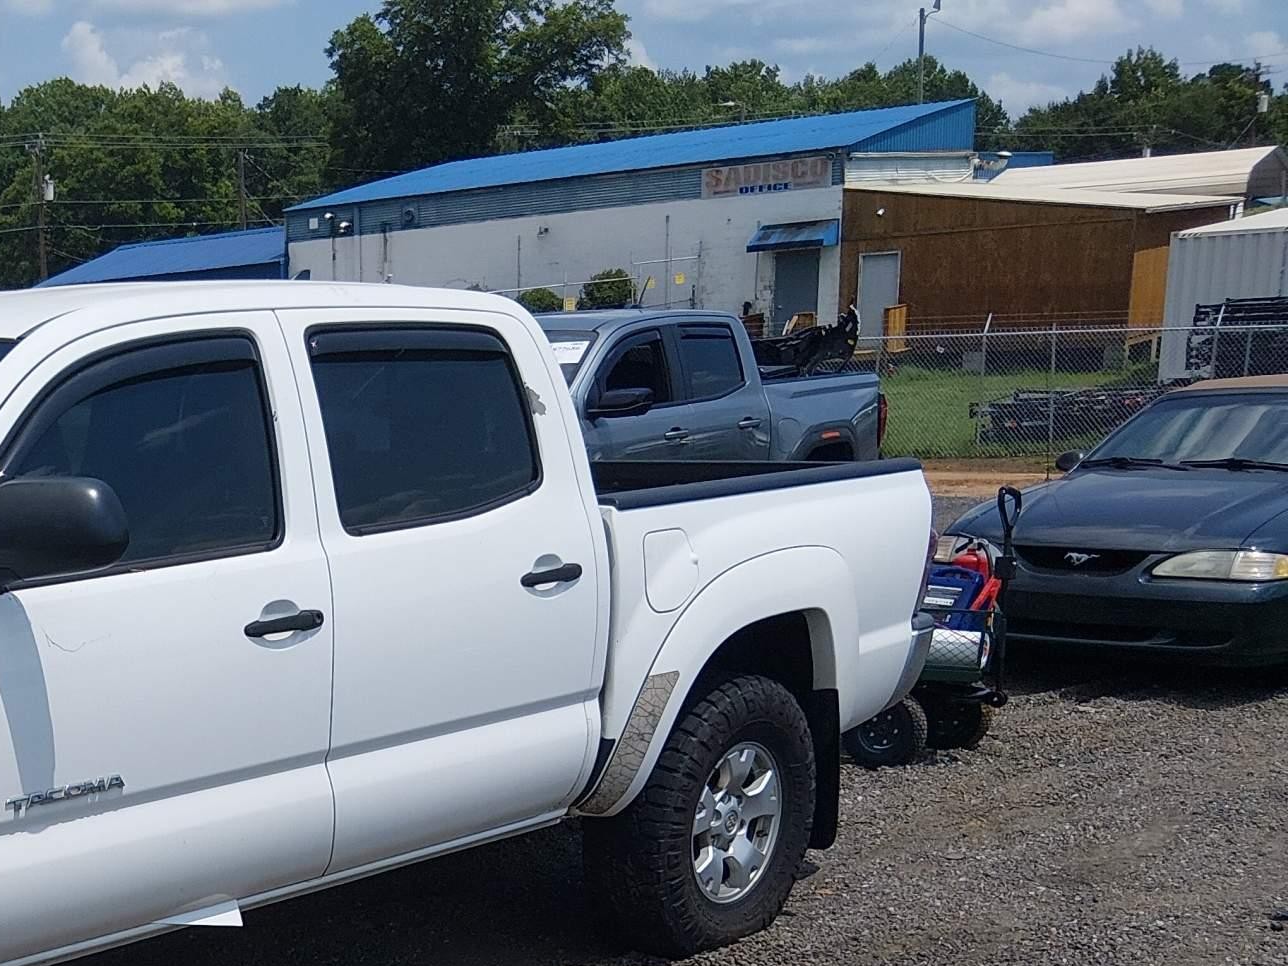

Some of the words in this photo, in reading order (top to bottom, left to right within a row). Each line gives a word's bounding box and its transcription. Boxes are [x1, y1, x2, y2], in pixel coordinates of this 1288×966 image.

[705, 158, 829, 189] SADISCO
[739, 183, 791, 194] OFFICE
[4, 775, 125, 812] TACOMA
